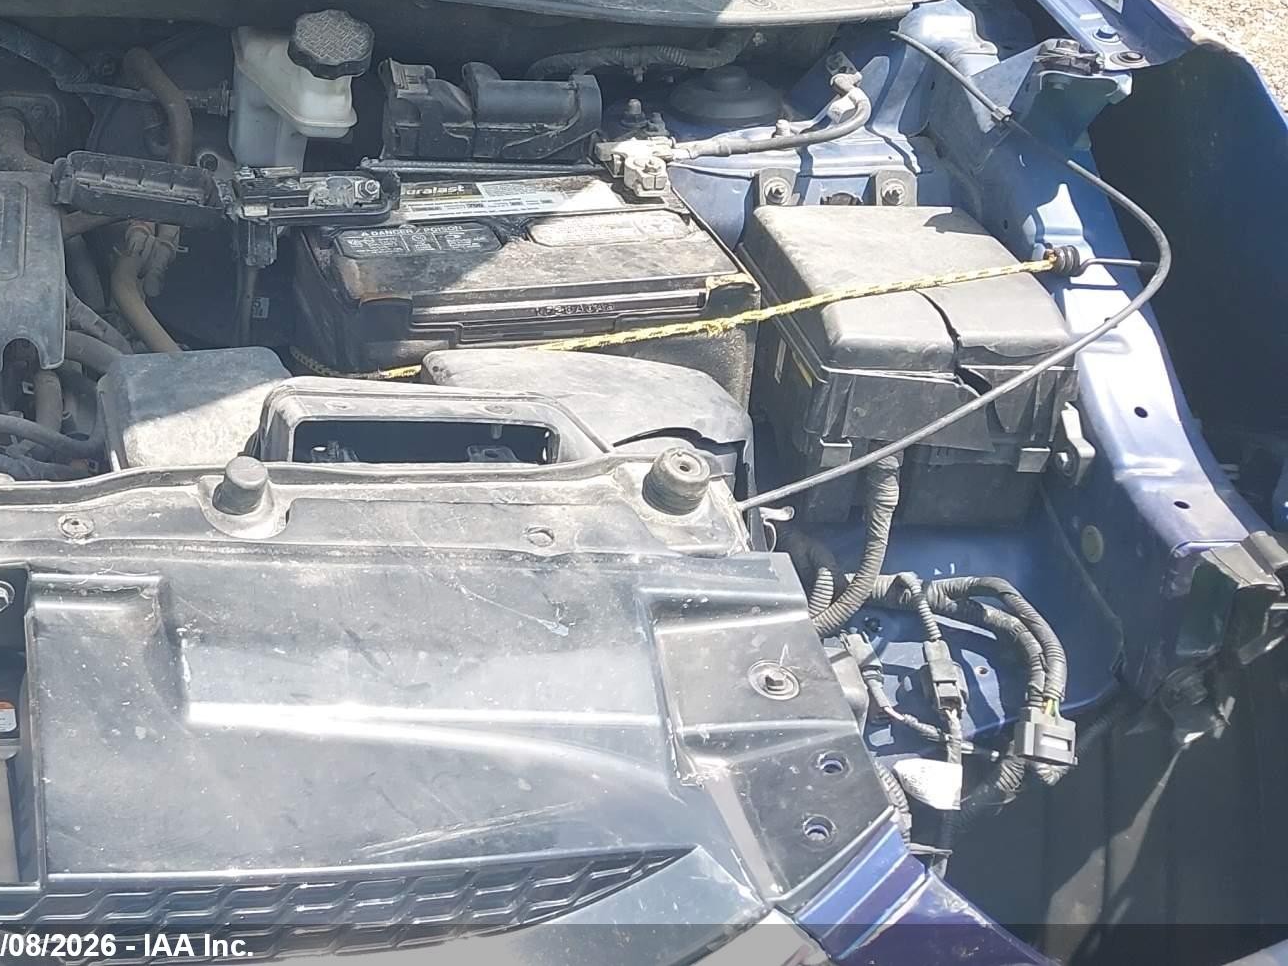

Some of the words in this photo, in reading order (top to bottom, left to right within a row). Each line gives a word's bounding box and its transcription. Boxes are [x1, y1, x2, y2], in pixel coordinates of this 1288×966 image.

[401, 184, 465, 196] uralast
[370, 229, 414, 237] DANGER
[423, 225, 463, 233] POISON
